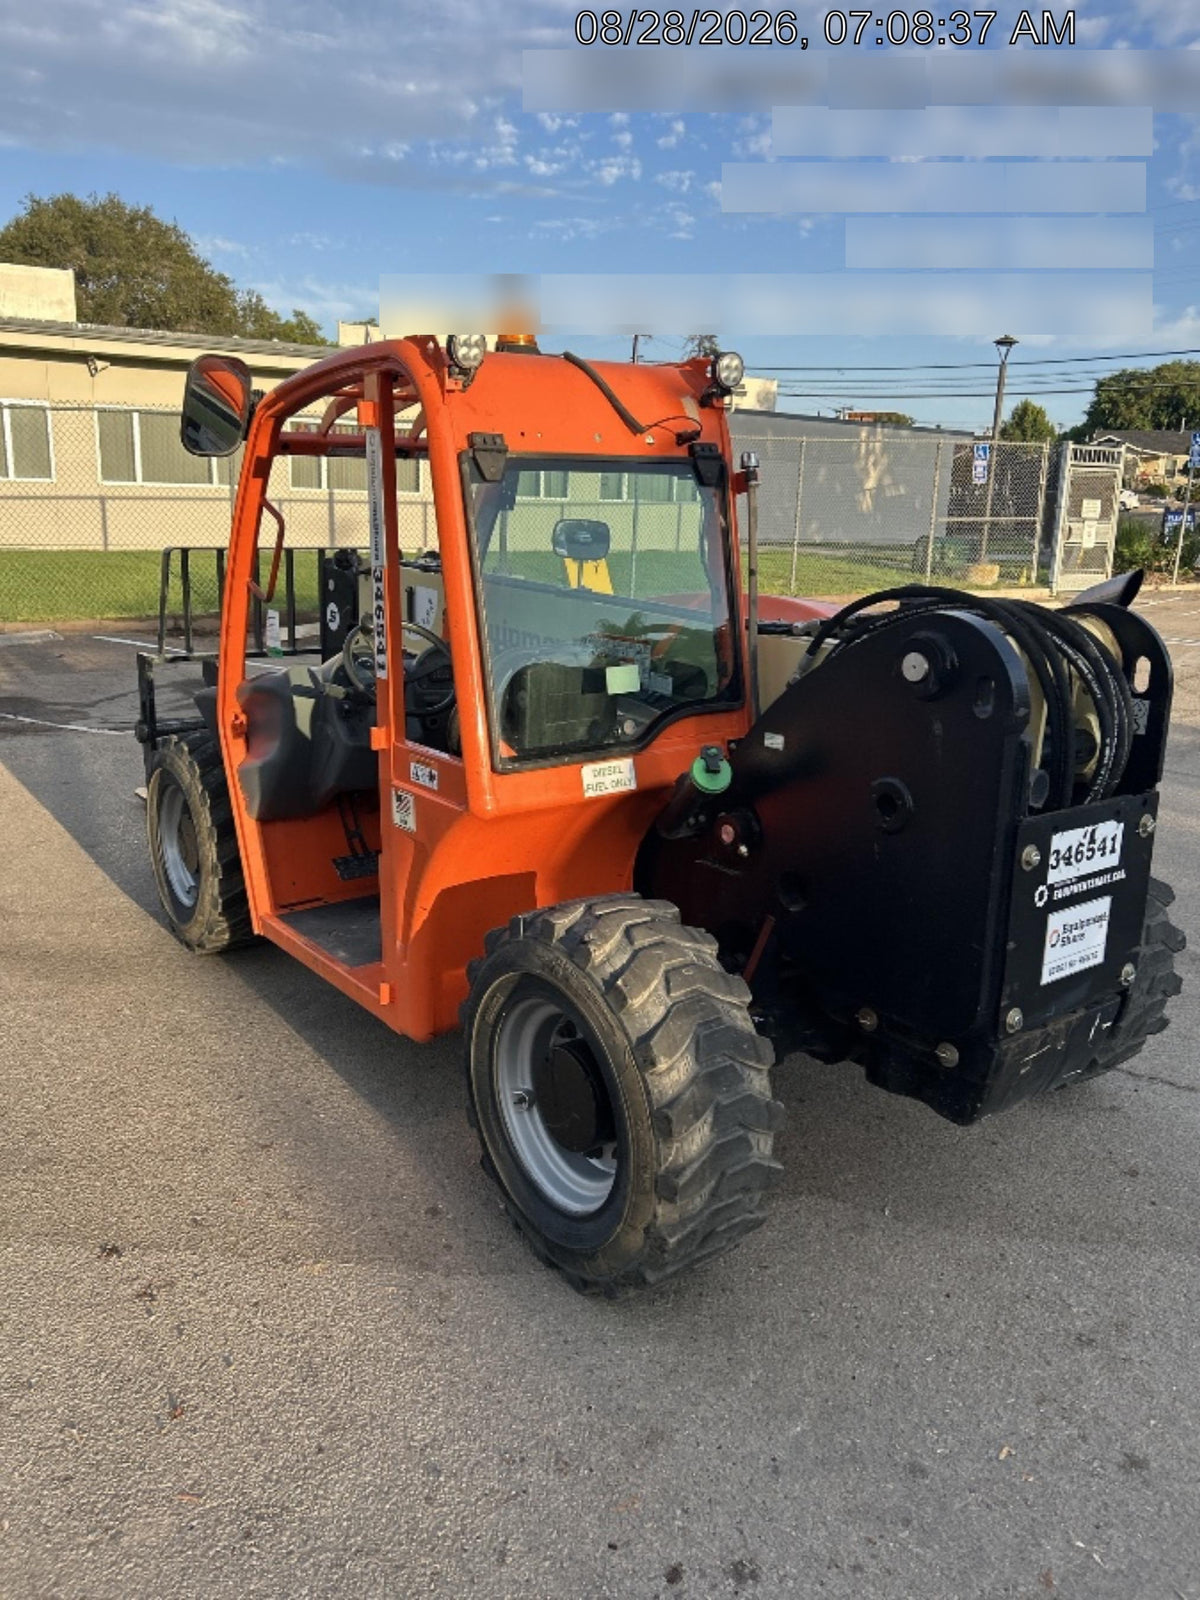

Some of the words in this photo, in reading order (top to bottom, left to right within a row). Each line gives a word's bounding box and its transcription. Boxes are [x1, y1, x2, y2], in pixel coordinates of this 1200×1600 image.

[373, 567, 386, 670] 346541
[592, 765, 624, 778] DIESEL
[586, 781, 609, 792] FUEL
[611, 778, 632, 788] ONLY
[1050, 833, 1118, 870] 346541
